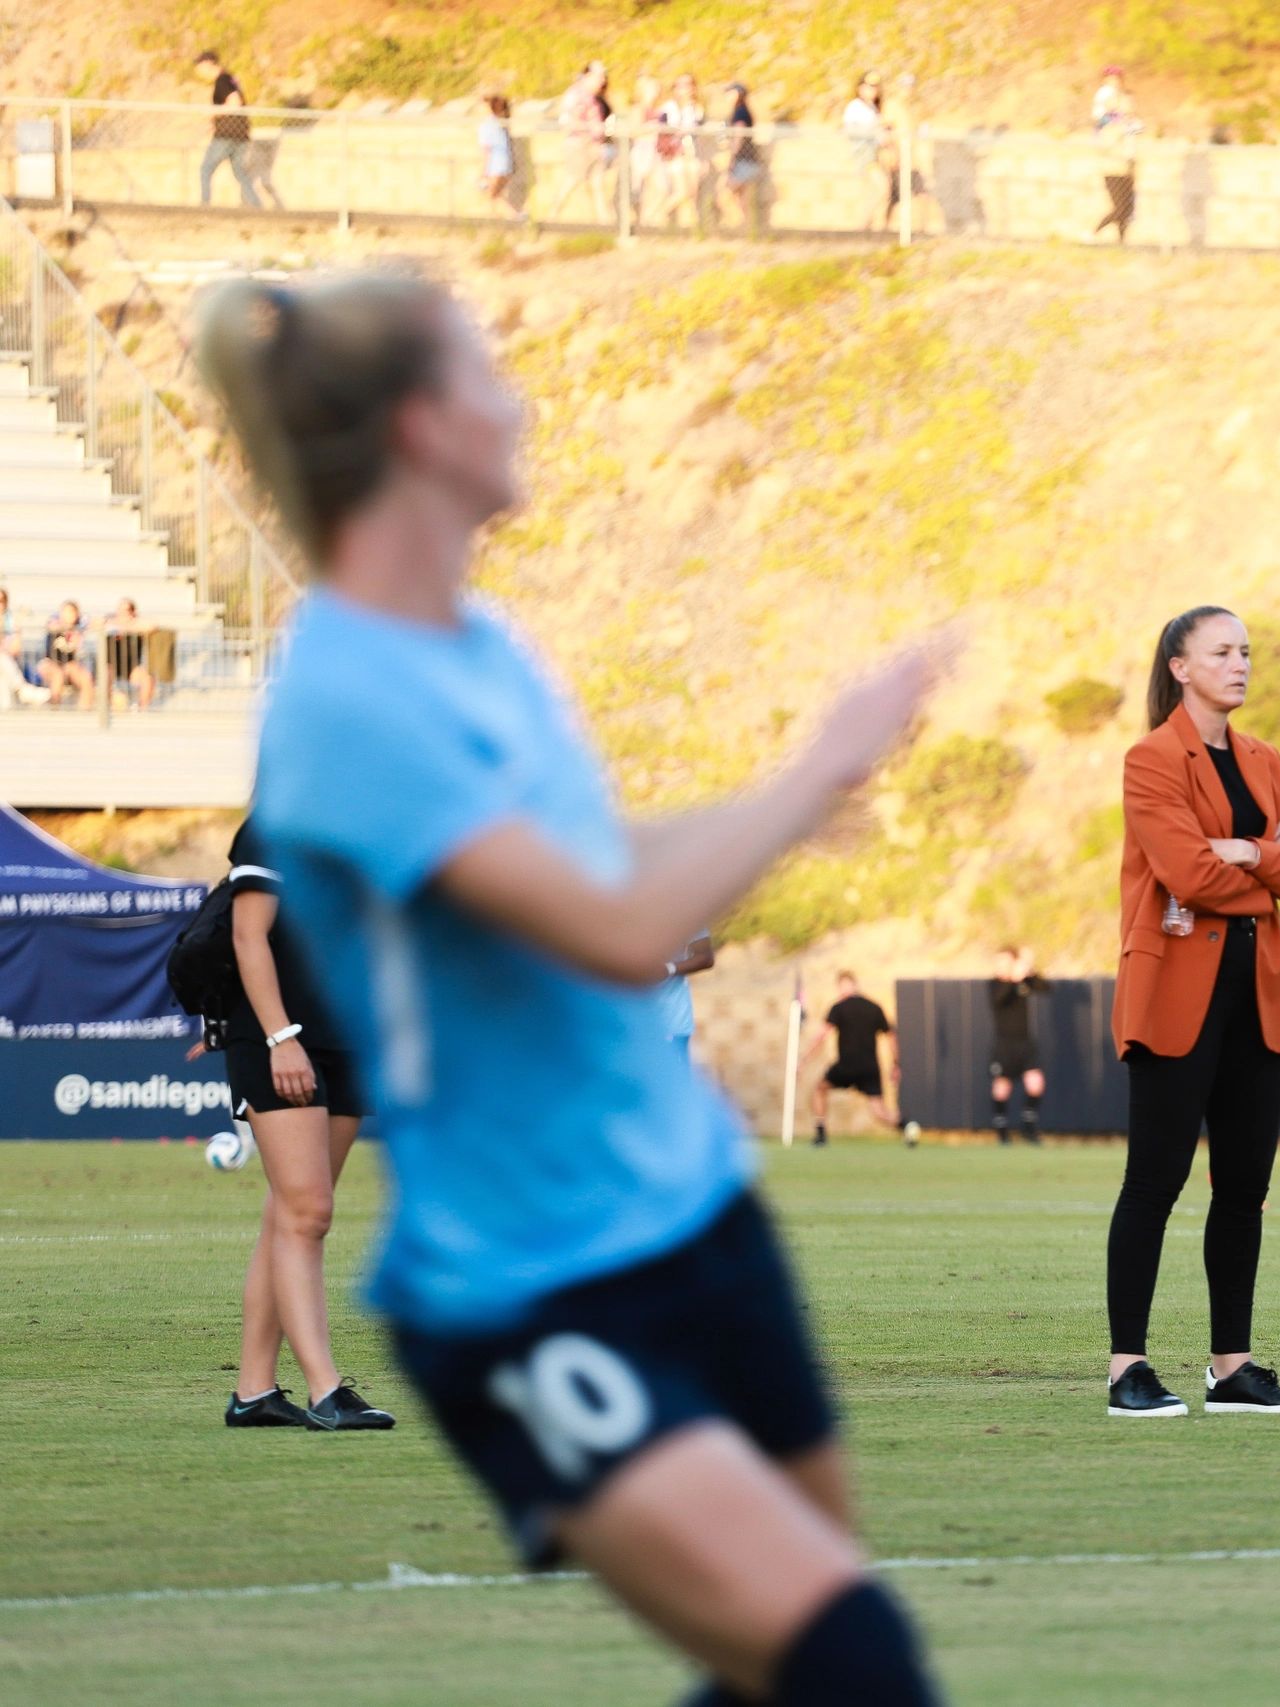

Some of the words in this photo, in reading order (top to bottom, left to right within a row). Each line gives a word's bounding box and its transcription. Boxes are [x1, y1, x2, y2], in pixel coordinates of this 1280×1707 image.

[20, 891, 109, 916] PHYSICIANS
[110, 889, 133, 914] OF
[133, 888, 181, 913] WAVE
